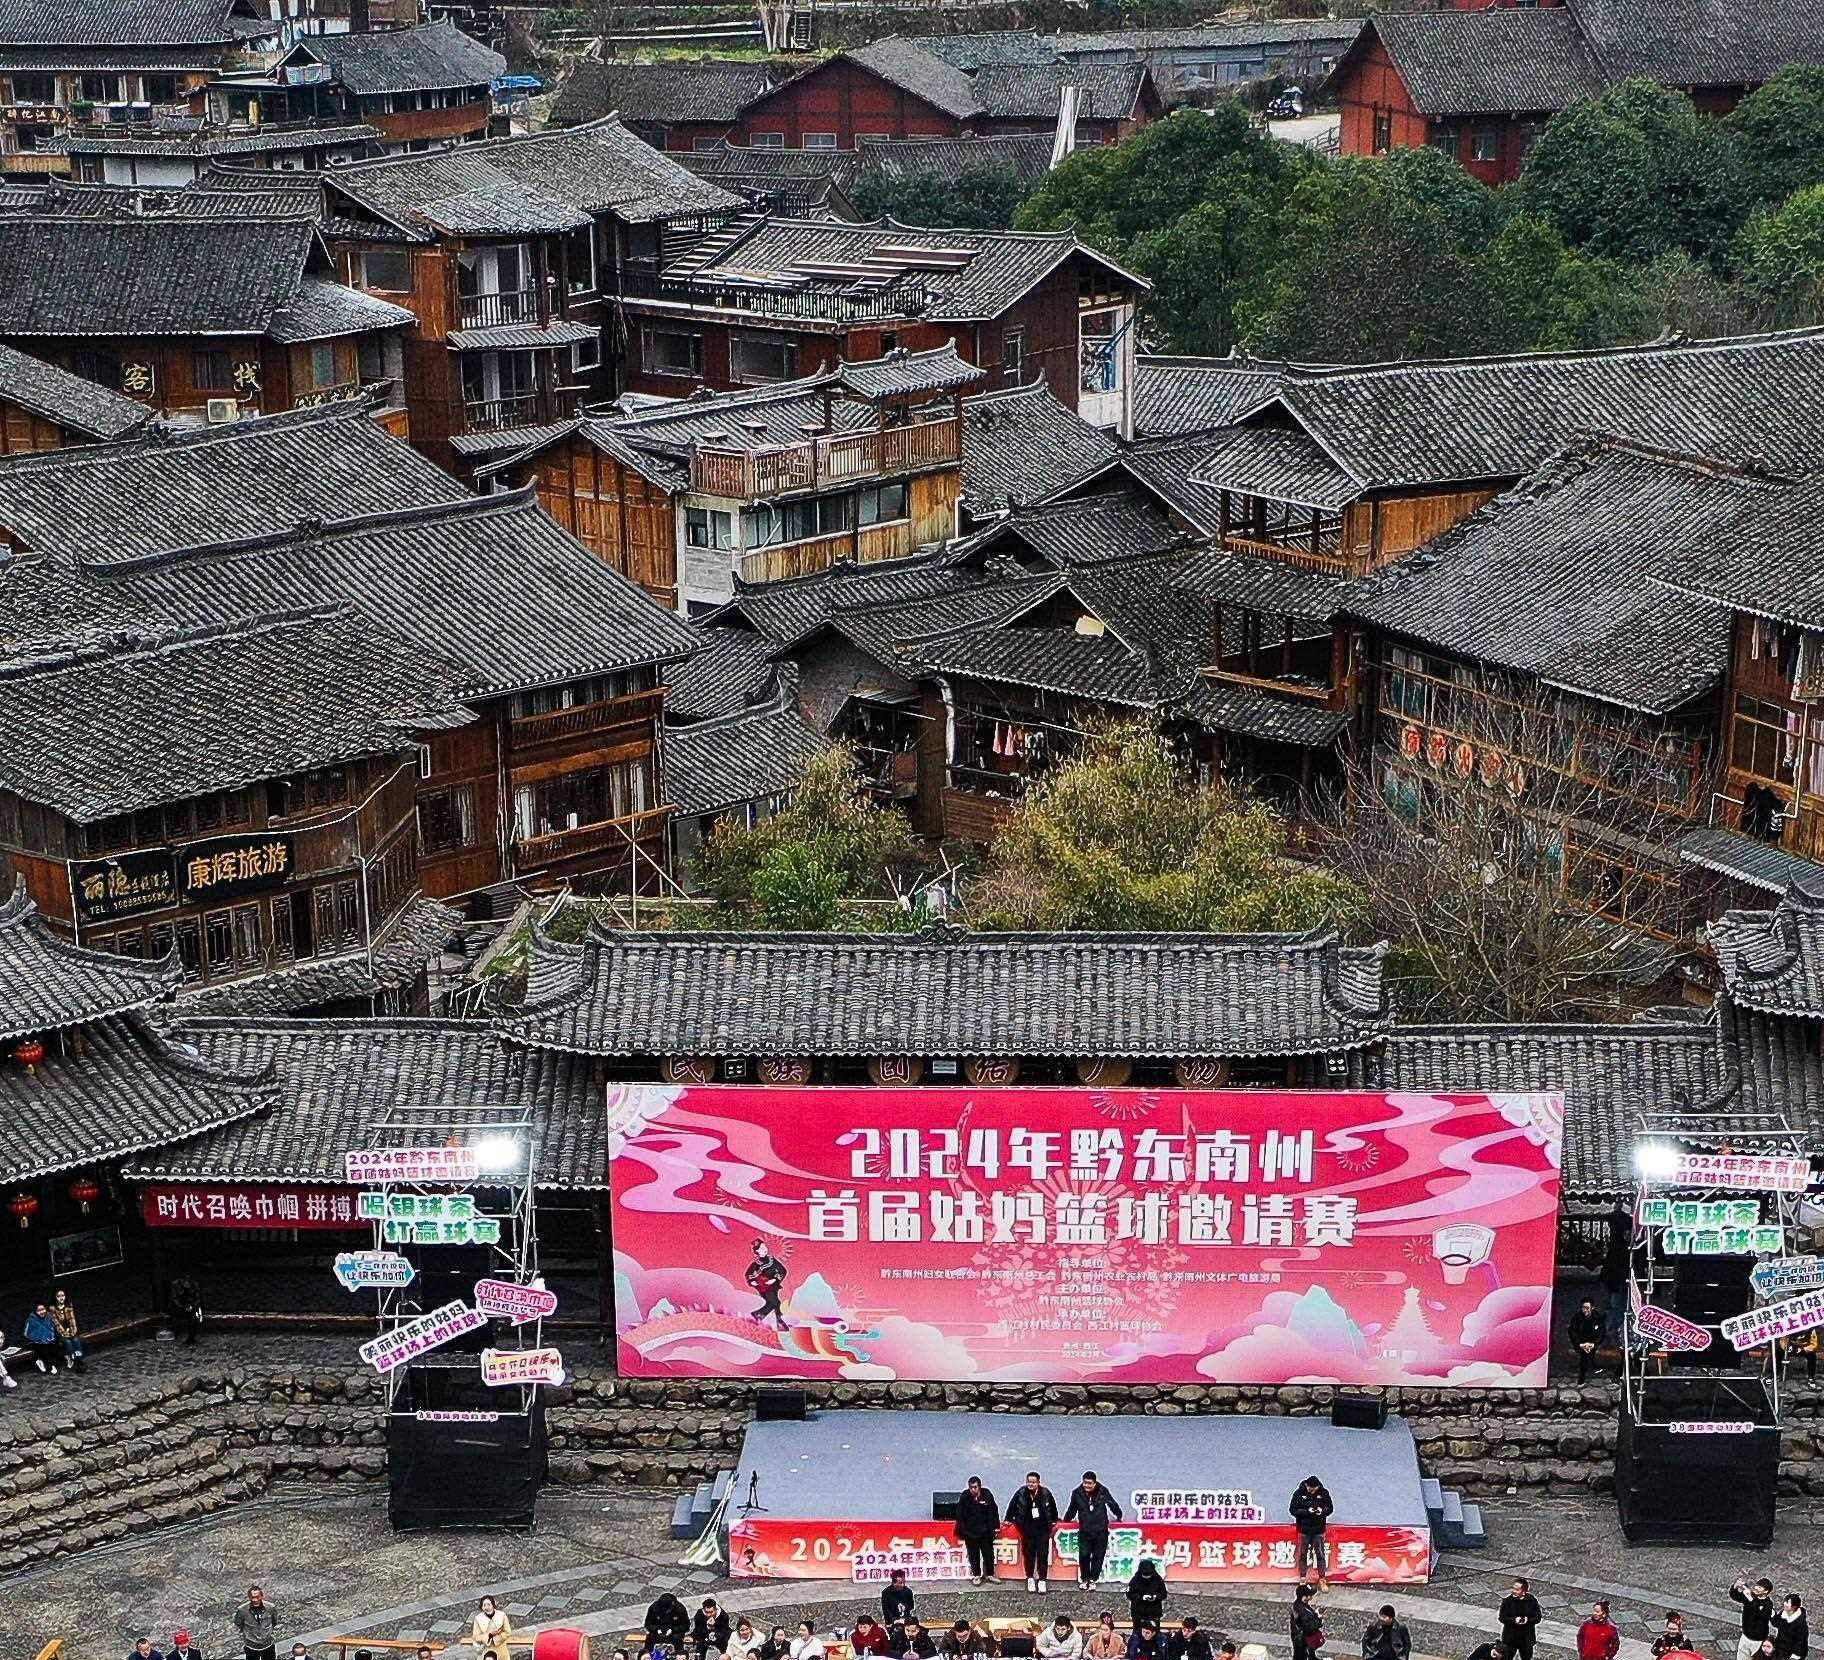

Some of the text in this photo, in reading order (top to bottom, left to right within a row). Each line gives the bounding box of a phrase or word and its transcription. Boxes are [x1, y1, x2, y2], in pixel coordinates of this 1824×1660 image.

[187, 841, 288, 890] 康辉旅游
[850, 1127, 1315, 1182] 2024年黔东南州
[157, 1193, 299, 1220] 时代召唤巾帼
[360, 1194, 473, 1218] 喝银球茶
[1642, 1201, 1759, 1225] 喝银球茶
[805, 1190, 1359, 1247] 首届姑妈篮球邀请赛
[385, 1220, 499, 1242] 打赢球赛
[1665, 1229, 1782, 1250] 打赢球赛
[1134, 1492, 1249, 1507] 美丽快乐的姑妈
[855, 1554, 967, 1566] 2024年黔东南
